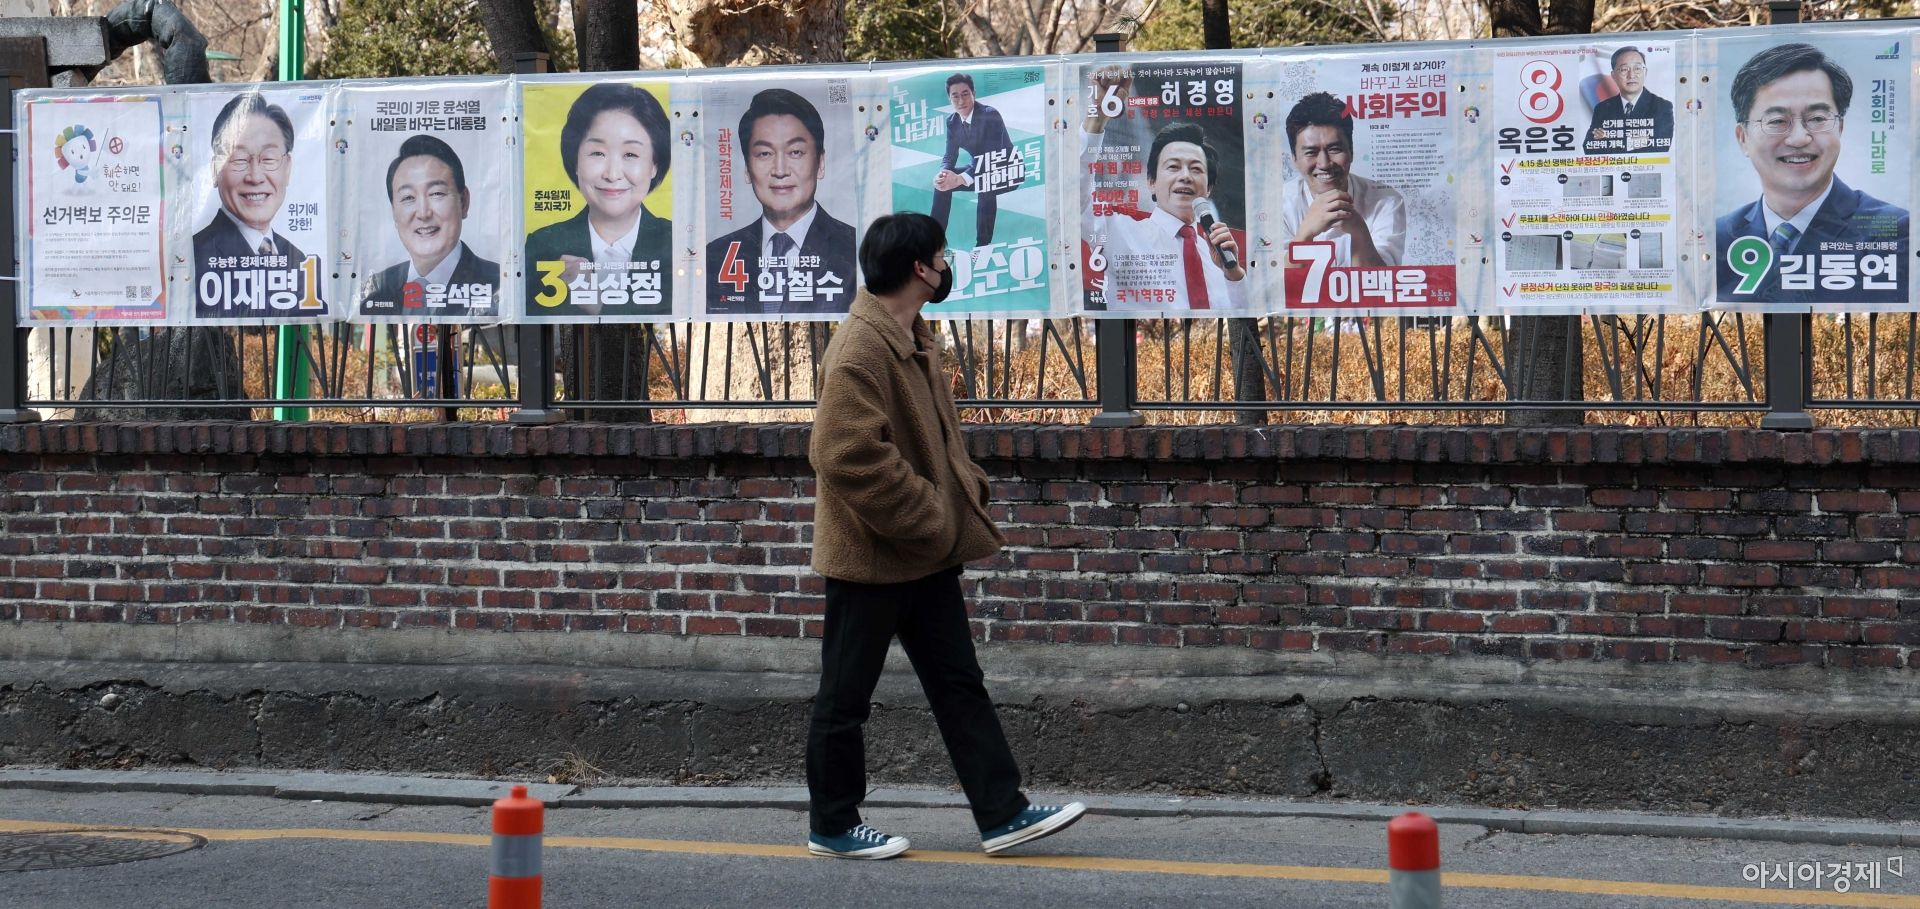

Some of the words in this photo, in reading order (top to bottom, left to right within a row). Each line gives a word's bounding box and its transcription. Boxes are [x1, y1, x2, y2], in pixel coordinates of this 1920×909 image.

[1138, 69, 1151, 78] 것이
[1153, 69, 1174, 77] 아니라
[1361, 63, 1379, 73] 계속
[1383, 62, 1410, 73] 이렇게
[1413, 60, 1446, 72] 살거야?
[1361, 76, 1400, 90] 바꾸고
[1406, 75, 1446, 89] 싶다면
[1518, 60, 1564, 124] 8
[376, 101, 413, 115] 국민이
[416, 101, 440, 115] 키운
[443, 100, 481, 115] 윤석열
[1101, 85, 1124, 118] 6
[1341, 91, 1447, 120] 사회주의
[1871, 79, 1887, 124] 기회의
[371, 117, 407, 132] 내일을
[409, 117, 446, 131] 바꾸는
[448, 116, 487, 131] 대통령
[894, 115, 945, 143] 나답게
[1602, 119, 1624, 129] 선거를
[1625, 118, 1654, 128] 국민에게
[1498, 125, 1576, 155] 옥은호
[1603, 130, 1624, 139] 자유를
[1625, 129, 1654, 138] 국민에게
[1586, 140, 1608, 149] 선관위
[974, 141, 1041, 174] 기본소득
[1871, 131, 1887, 174] 나라로
[1536, 159, 1551, 168] 총선
[1552, 158, 1574, 167] 명백한
[974, 160, 1041, 193] 대한민국
[108, 180, 119, 192] 안
[534, 190, 571, 201] 주4일제
[288, 203, 318, 216] 위기에
[534, 201, 571, 212] 복지국가
[43, 205, 102, 225] 선거벽보
[107, 205, 151, 224] 주의문
[1520, 214, 1549, 223] 투표지를
[1581, 213, 1596, 222] 다시
[288, 218, 313, 232] 강한!
[1820, 241, 1854, 251] 품격있는
[1855, 241, 1898, 251] 경제대통령
[208, 256, 238, 268] 유능한
[240, 255, 288, 268] 경제대통령
[758, 255, 788, 268] 바르고
[790, 255, 821, 268] 깨끗한
[1089, 245, 1108, 272] 6
[1727, 235, 1774, 294] 9
[1779, 254, 1898, 290] 김동연
[718, 241, 749, 292] 4
[757, 270, 844, 302] 안철수
[1292, 244, 1332, 304] 7
[1328, 269, 1428, 303] 이백윤
[200, 269, 299, 310] 이재명
[299, 254, 324, 310] 1
[534, 260, 569, 307] 3
[568, 272, 663, 305] 심상정
[1520, 282, 1553, 291] 부정선거
[1571, 282, 1593, 291] 못하면
[1620, 281, 1634, 291] 길로
[1636, 281, 1658, 290] 갑니다
[402, 281, 424, 308] 2
[425, 283, 493, 308] 윤석열
[1116, 289, 1177, 303] 국가혁명당
